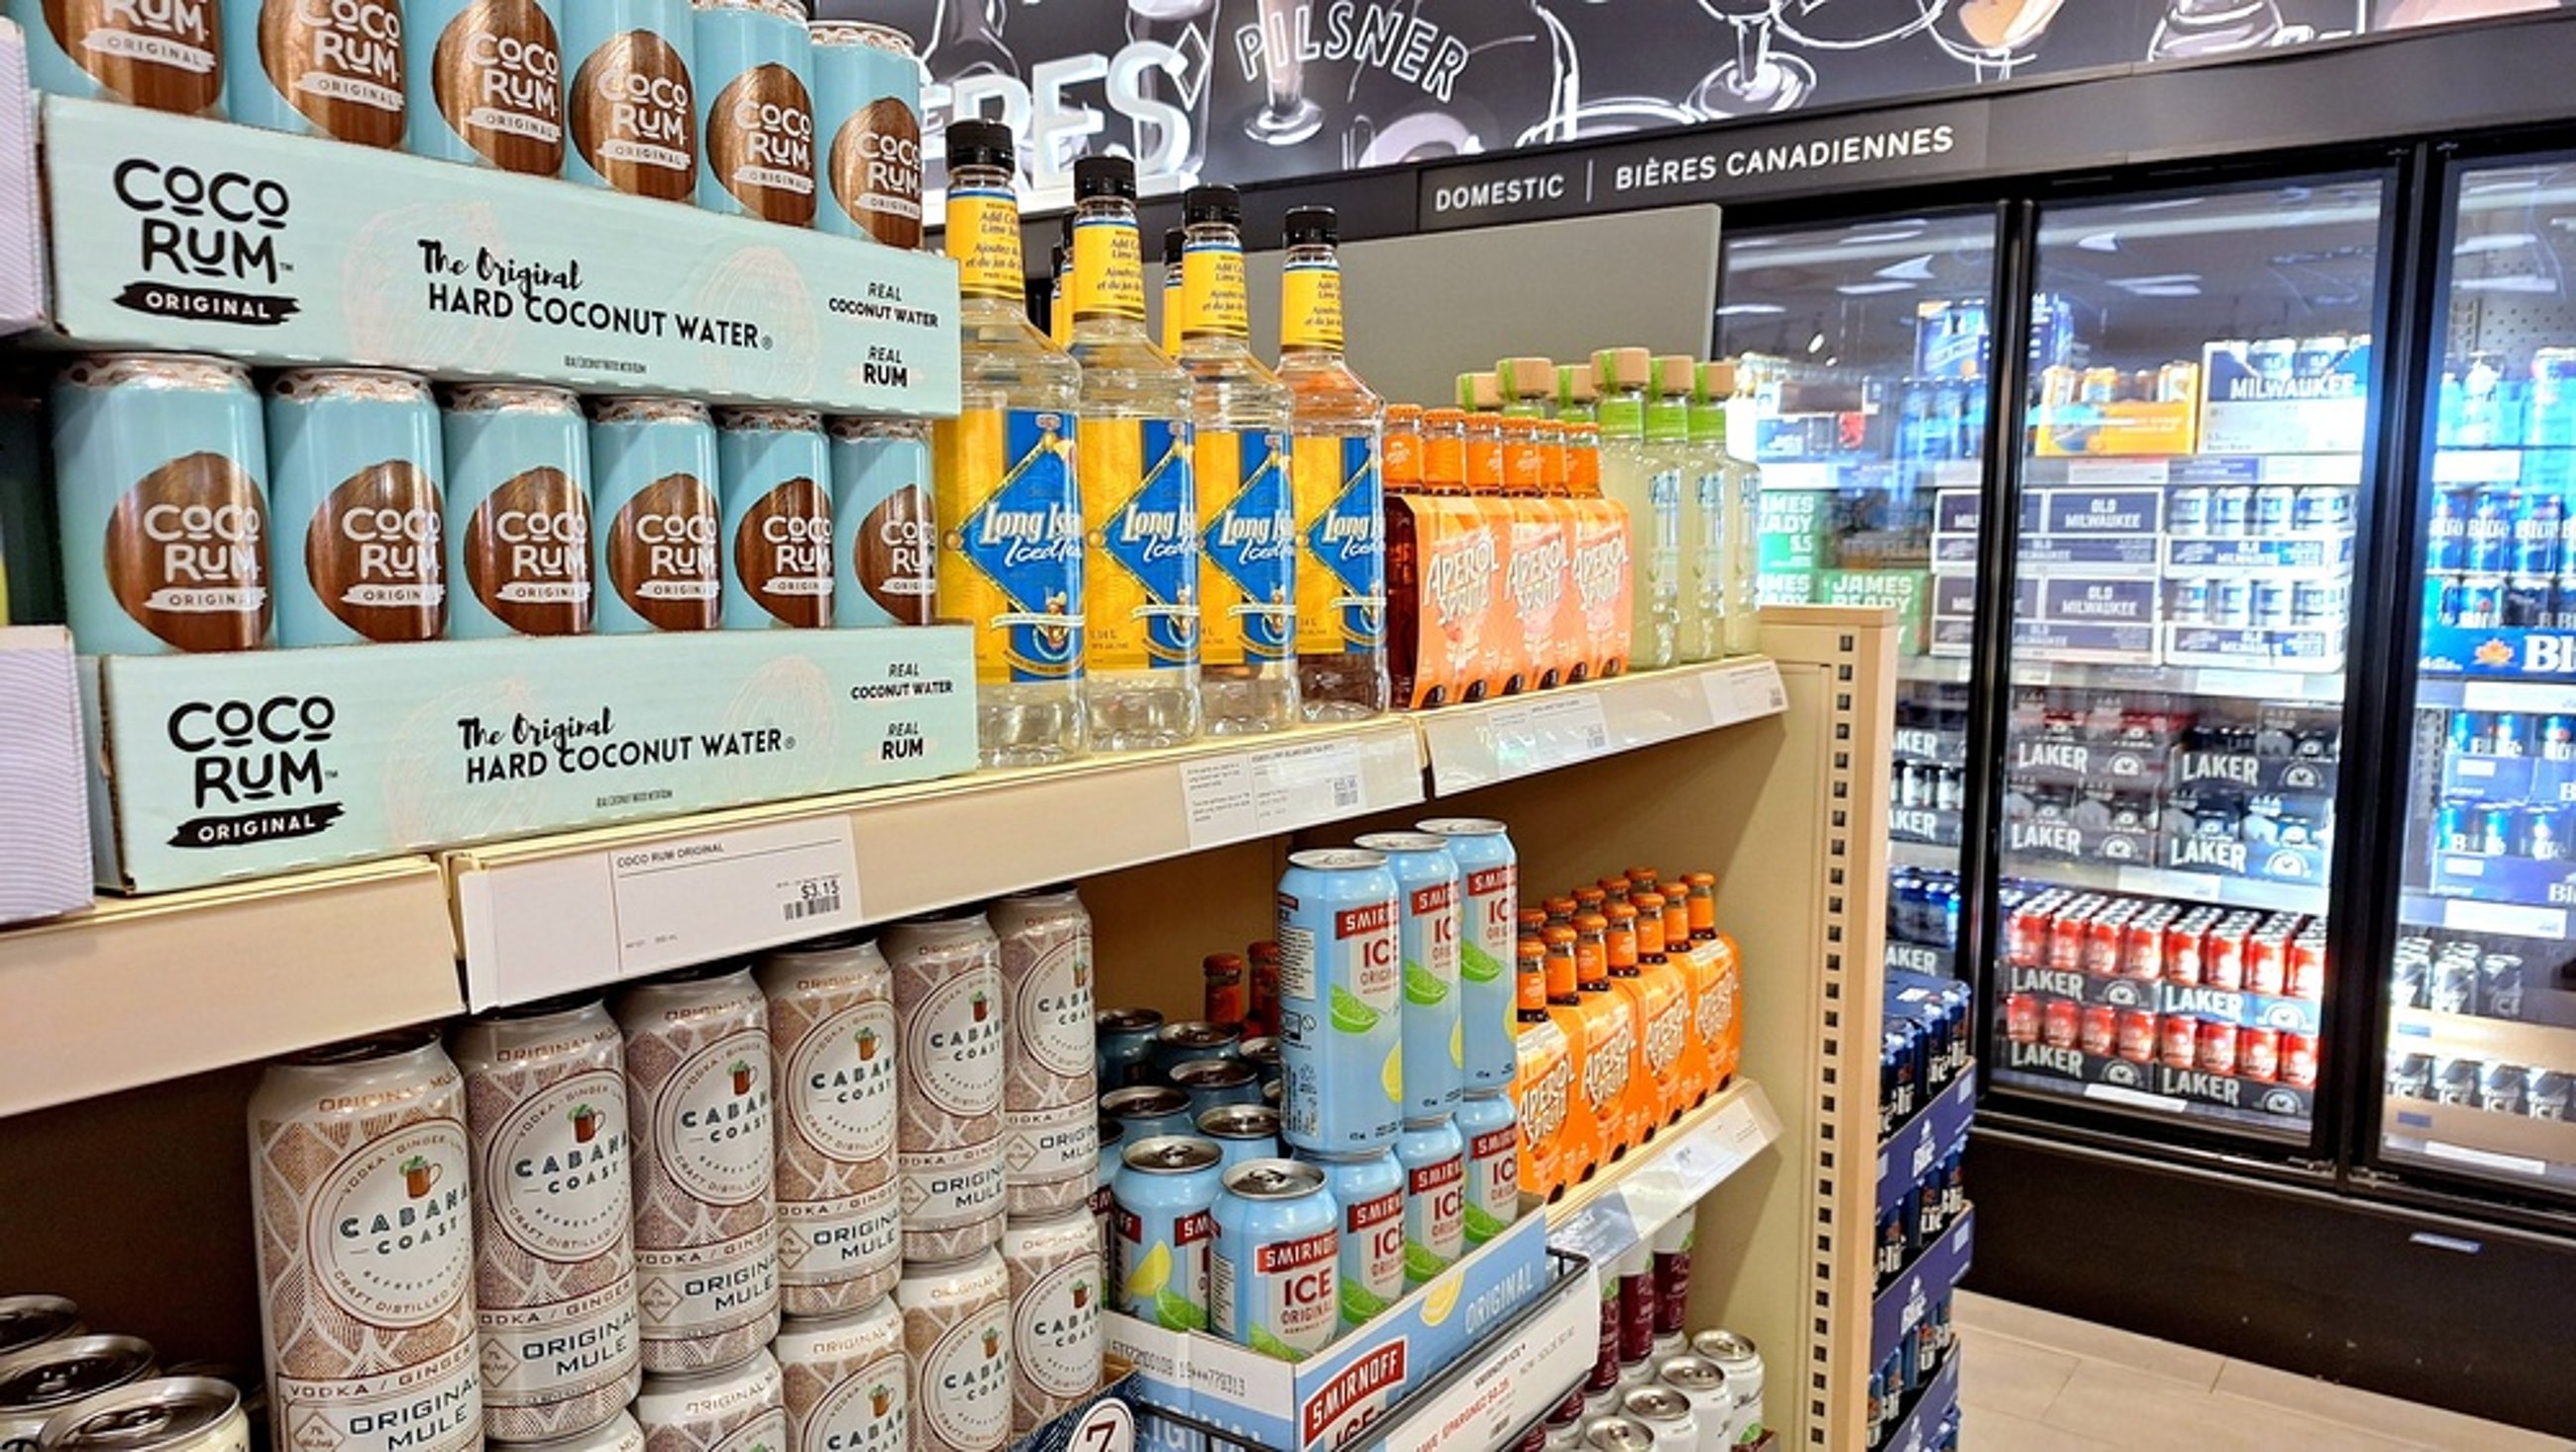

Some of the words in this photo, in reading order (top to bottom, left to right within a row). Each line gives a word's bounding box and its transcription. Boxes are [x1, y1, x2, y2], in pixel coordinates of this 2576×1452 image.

[106, 36, 202, 66] ORIGINAL
[313, 32, 400, 82] RUM
[467, 33, 559, 82] COCO
[1234, 1, 1469, 102] PILSNER
[318, 79, 398, 106] ORIGINAL
[483, 70, 558, 117] RUM
[596, 69, 687, 111] COCO
[612, 105, 686, 146] RUM
[733, 101, 811, 137] COCO
[748, 134, 809, 172] RUM
[1615, 154, 1717, 191] BIÈRES
[1726, 125, 1955, 176] CANADIENNES
[113, 157, 289, 229] COCO
[868, 161, 921, 198] RUM
[1435, 173, 1565, 212] DOMESTIC
[141, 217, 277, 284] RUM
[418, 239, 469, 276] The
[477, 247, 583, 298] Original
[146, 289, 271, 319] ORIGINAL
[428, 282, 513, 318] HARD
[524, 295, 667, 338] COCONUT
[867, 281, 903, 302] REAL
[827, 297, 893, 322] COCONUT
[894, 305, 939, 329] WATER
[867, 346, 904, 365] REAL
[862, 362, 909, 387] RUM
[2229, 372, 2357, 399] MILWAUKEE
[143, 504, 261, 541] COCO
[342, 506, 441, 541] COCO
[979, 501, 1047, 545] Long
[1121, 502, 1179, 543] Long
[2065, 513, 2142, 529] MILWAUKEE
[2091, 498, 2116, 513] OLD
[496, 510, 589, 544] COCO
[636, 514, 716, 545] COCO
[1219, 508, 1270, 546] Long
[1322, 508, 1369, 544] Long
[163, 543, 258, 582] RUM
[1424, 535, 1500, 606] APEROL
[1832, 575, 1913, 593] JAMES
[2061, 600, 2139, 617] MILWAUKEE
[888, 663, 919, 677] REAL
[850, 682, 910, 699] COCONUT
[912, 679, 953, 695] WATER
[167, 695, 335, 753] COCO
[458, 717, 504, 750] The
[511, 706, 615, 755] Original
[887, 722, 919, 737] REAL
[467, 751, 547, 783] HARD
[558, 736, 694, 774] COCONUT
[882, 737, 923, 761] RUM
[1892, 729, 1938, 759] KER
[2018, 742, 2088, 775] LAKER
[194, 749, 324, 809] RUM
[2183, 753, 2259, 786] LAKER
[198, 813, 317, 843] ORIGINAL
[2010, 823, 2082, 857] LAKER
[616, 854, 649, 869] COCO
[651, 849, 675, 863] RUM
[677, 843, 724, 859] ORIGINAL
[2170, 837, 2247, 875] LAKER
[2011, 967, 2085, 1002] LAKER
[2166, 985, 2243, 1022] LAKER
[2011, 1045, 2084, 1080] LAKER
[2162, 1068, 2240, 1107] LAKER
[2528, 1099, 2562, 1121] ICE
[548, 1162, 618, 1194] COAST
[376, 1216, 457, 1256] COAST
[813, 1207, 900, 1246] ORIGINA
[841, 1227, 896, 1262] MULE
[1264, 1231, 1339, 1269] SMIRNOFF
[684, 1253, 777, 1296] ORIGINA
[714, 1274, 775, 1312] MULE
[1283, 1268, 1332, 1306] ICE
[1280, 1299, 1333, 1325] ORIGINAL
[1465, 1268, 1534, 1335] ORIGINAL
[522, 1310, 637, 1360] ORIGINAL
[288, 1381, 371, 1398] VODKA
[397, 1344, 472, 1388] GINGER
[555, 1336, 628, 1377] MULE
[1313, 1349, 1398, 1430] SMIRNOFF
[387, 1402, 468, 1452] MULE
